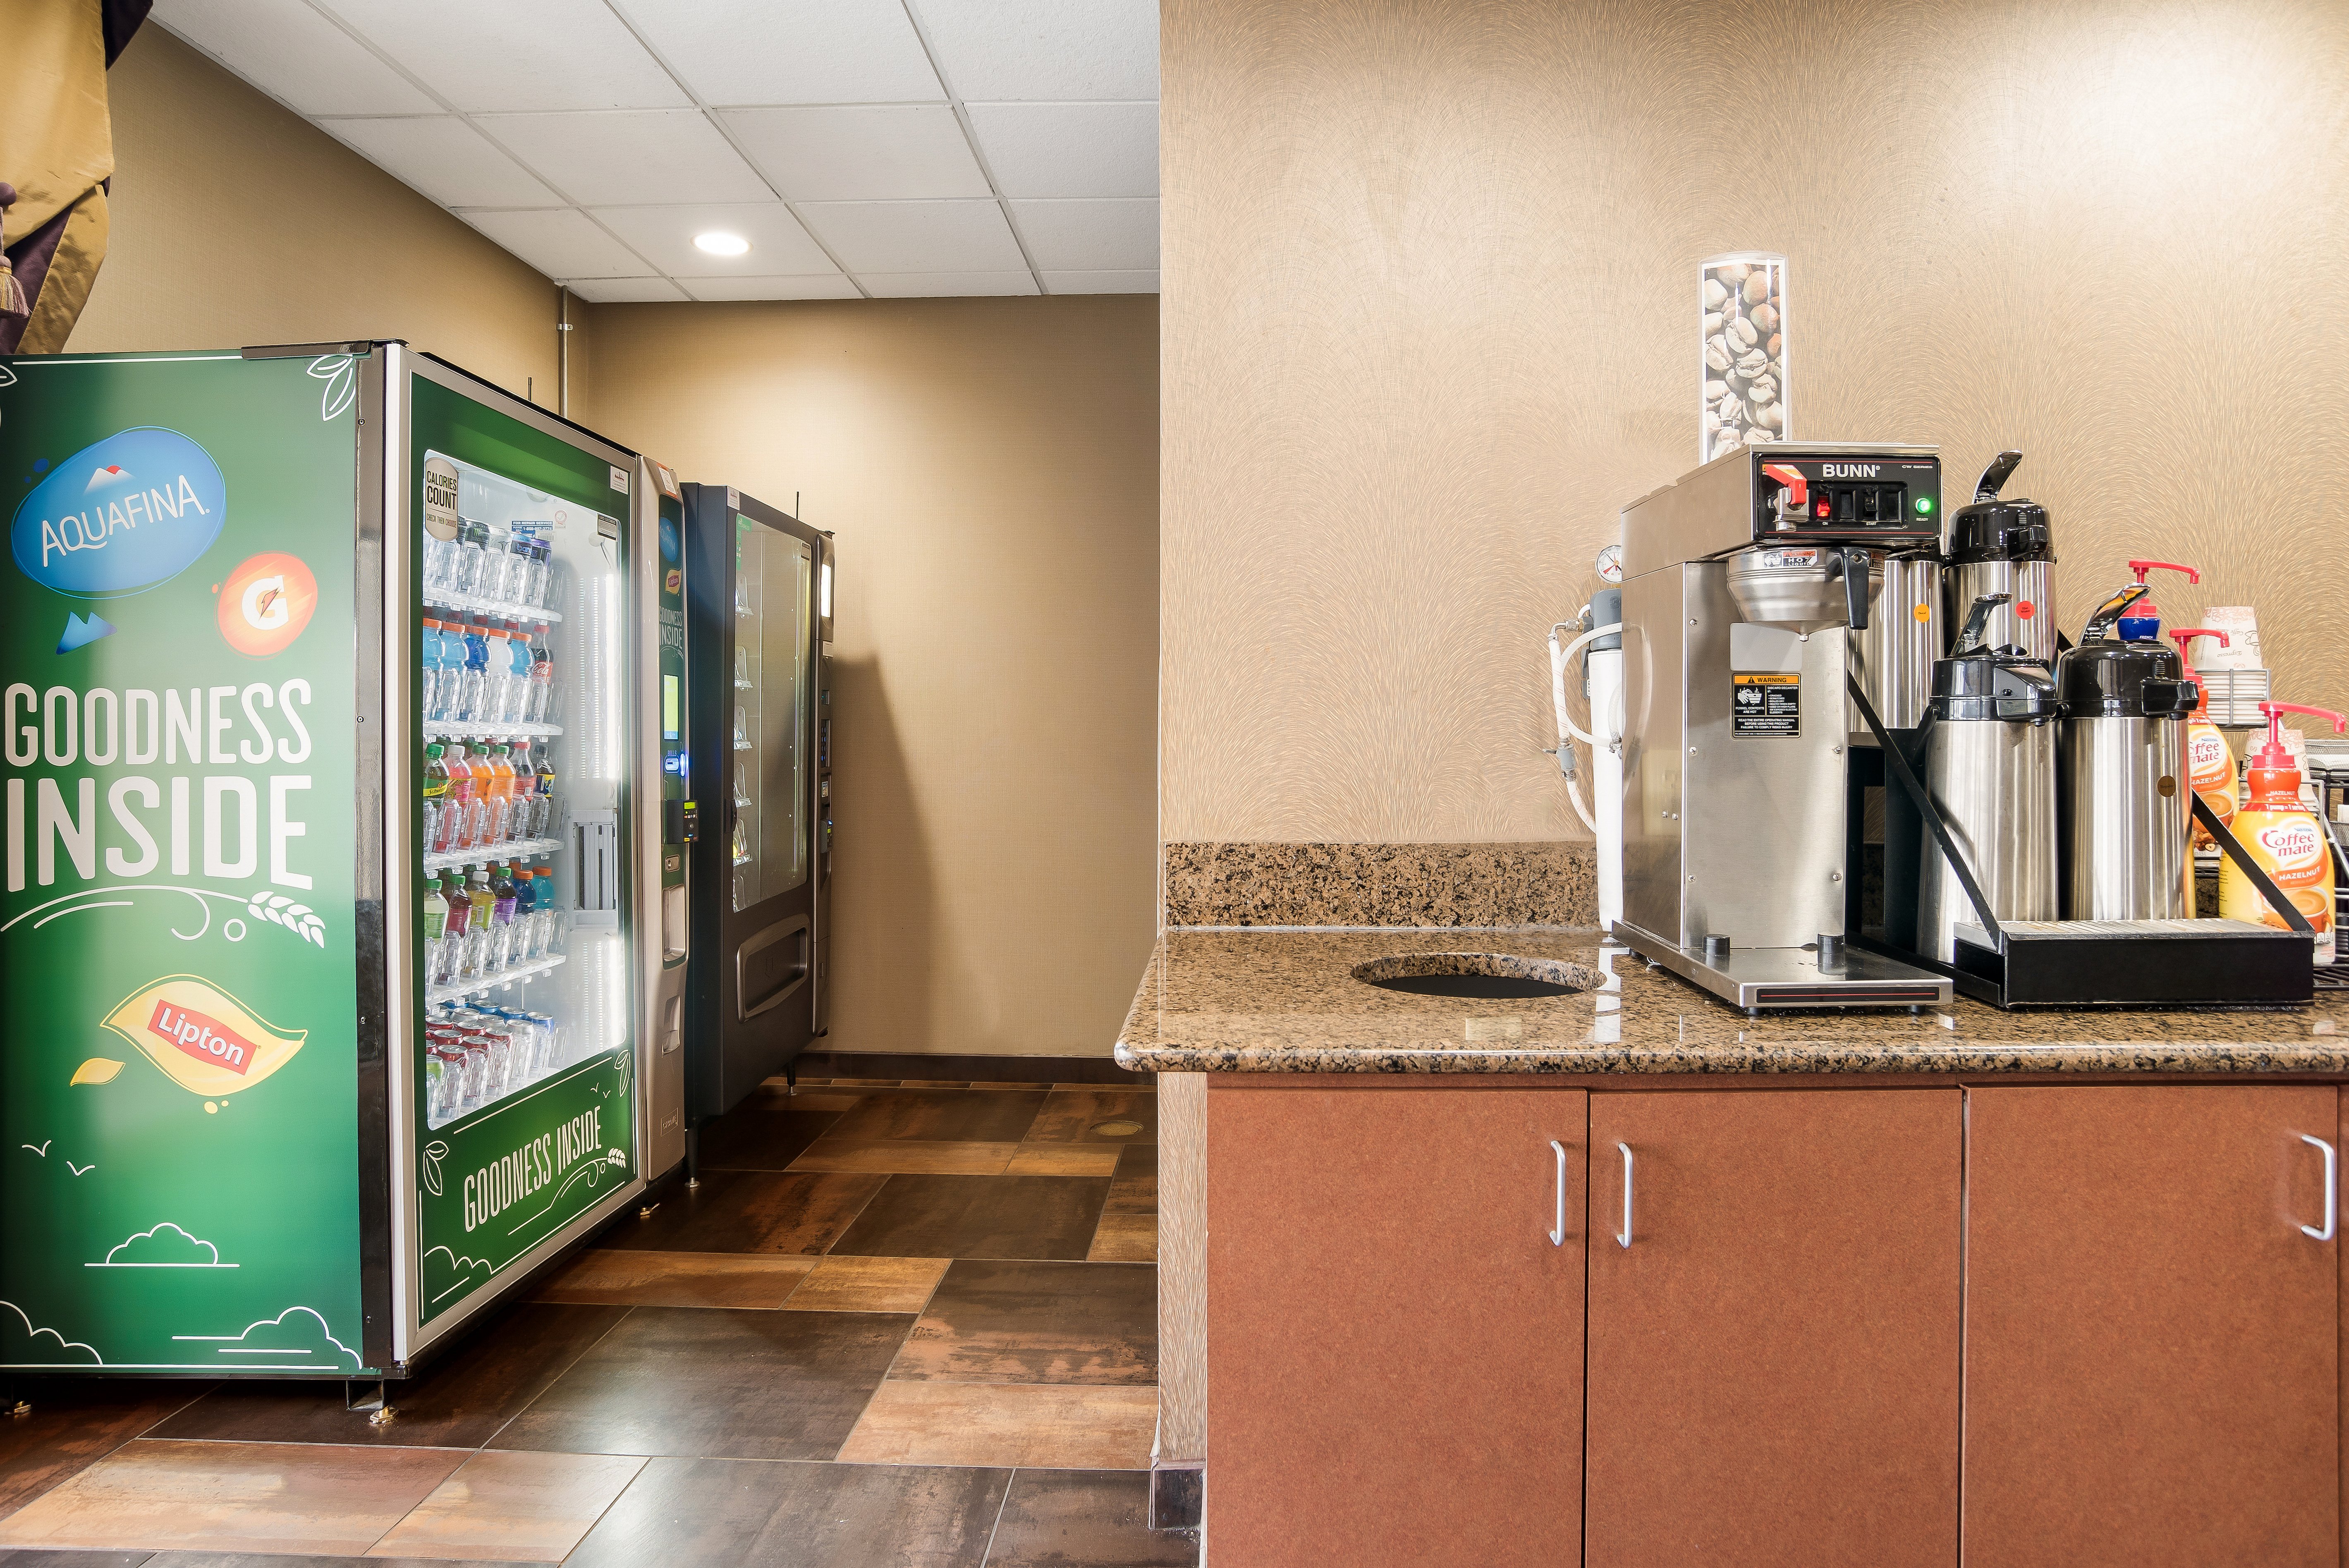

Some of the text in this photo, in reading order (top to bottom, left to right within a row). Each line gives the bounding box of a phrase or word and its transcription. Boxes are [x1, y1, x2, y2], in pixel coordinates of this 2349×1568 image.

[427, 471, 457, 491] CALORIES
[1823, 464, 1876, 478] BUNN
[427, 485, 457, 510] COUNT
[42, 475, 207, 567] AQUAFINA
[427, 513, 436, 523] CHECK
[445, 519, 457, 528] CHOOSE
[242, 575, 289, 631] G
[659, 605, 682, 626] GOODNESS
[660, 624, 683, 650] INSIDE
[5, 678, 311, 767] GOODNESS
[2189, 742, 2219, 755] offee
[7, 775, 313, 892] INSIDE
[2262, 830, 2314, 848] Coffee
[2277, 844, 2314, 856] mate
[2279, 865, 2320, 881] HAZELNUT
[158, 1008, 245, 1066] Lipton
[464, 1105, 602, 1233] GOODNESS INSIDE
